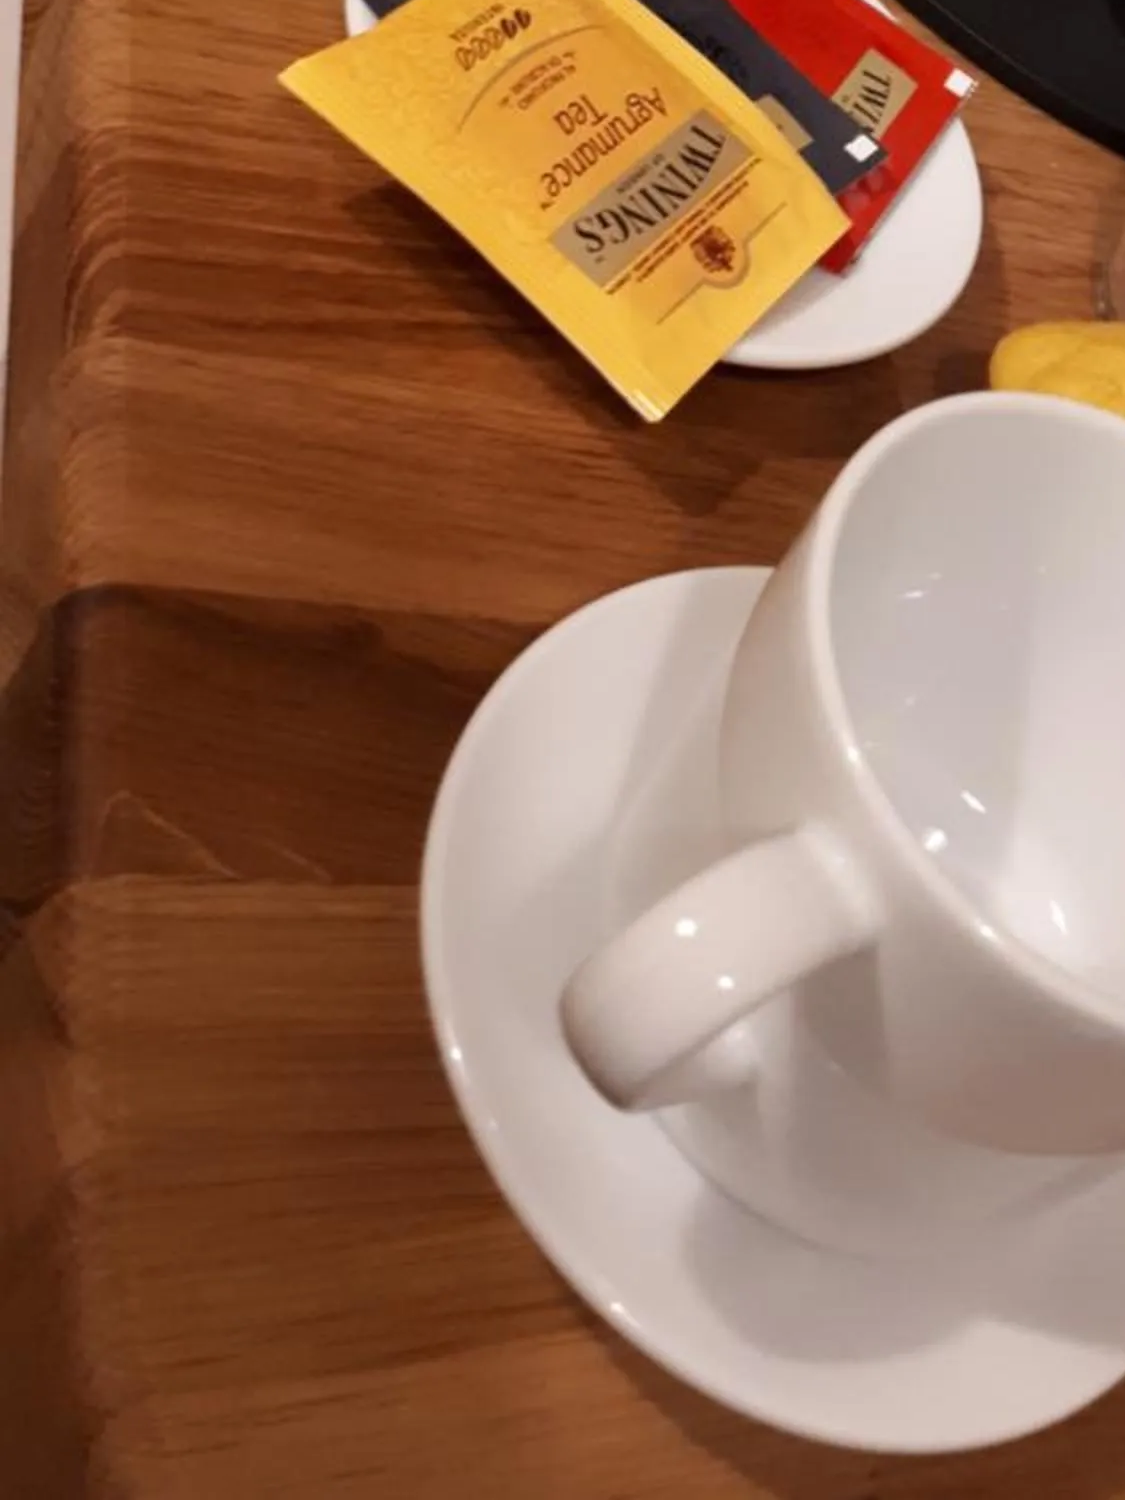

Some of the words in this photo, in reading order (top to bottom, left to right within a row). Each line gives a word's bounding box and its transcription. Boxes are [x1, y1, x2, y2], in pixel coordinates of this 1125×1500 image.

[552, 94, 609, 136] Tea
[853, 69, 892, 132] TWI
[573, 124, 727, 254] TWININGS
